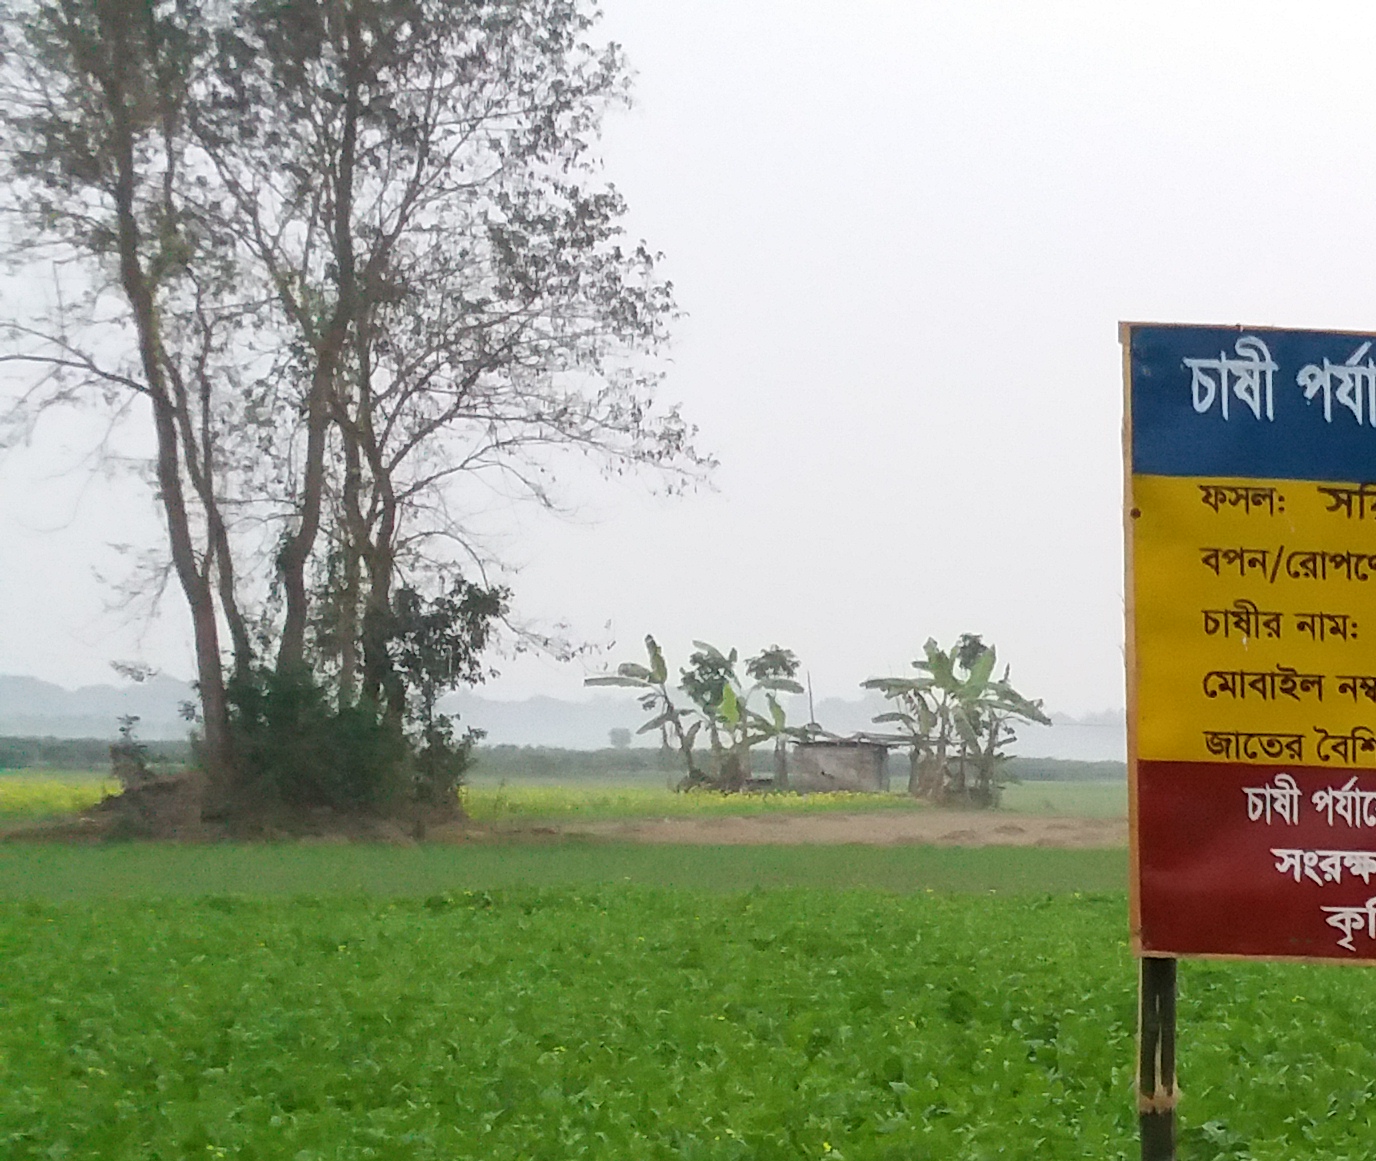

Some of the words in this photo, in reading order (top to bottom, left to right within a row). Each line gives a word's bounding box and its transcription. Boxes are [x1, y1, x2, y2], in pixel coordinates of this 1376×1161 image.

[1182, 335, 1279, 421] চাষী
[1201, 599, 1283, 640] চাষীর
[1202, 664, 1325, 703] মোবাইল
[1202, 730, 1306, 761] জাতের
[1242, 773, 1302, 826] চাষী
